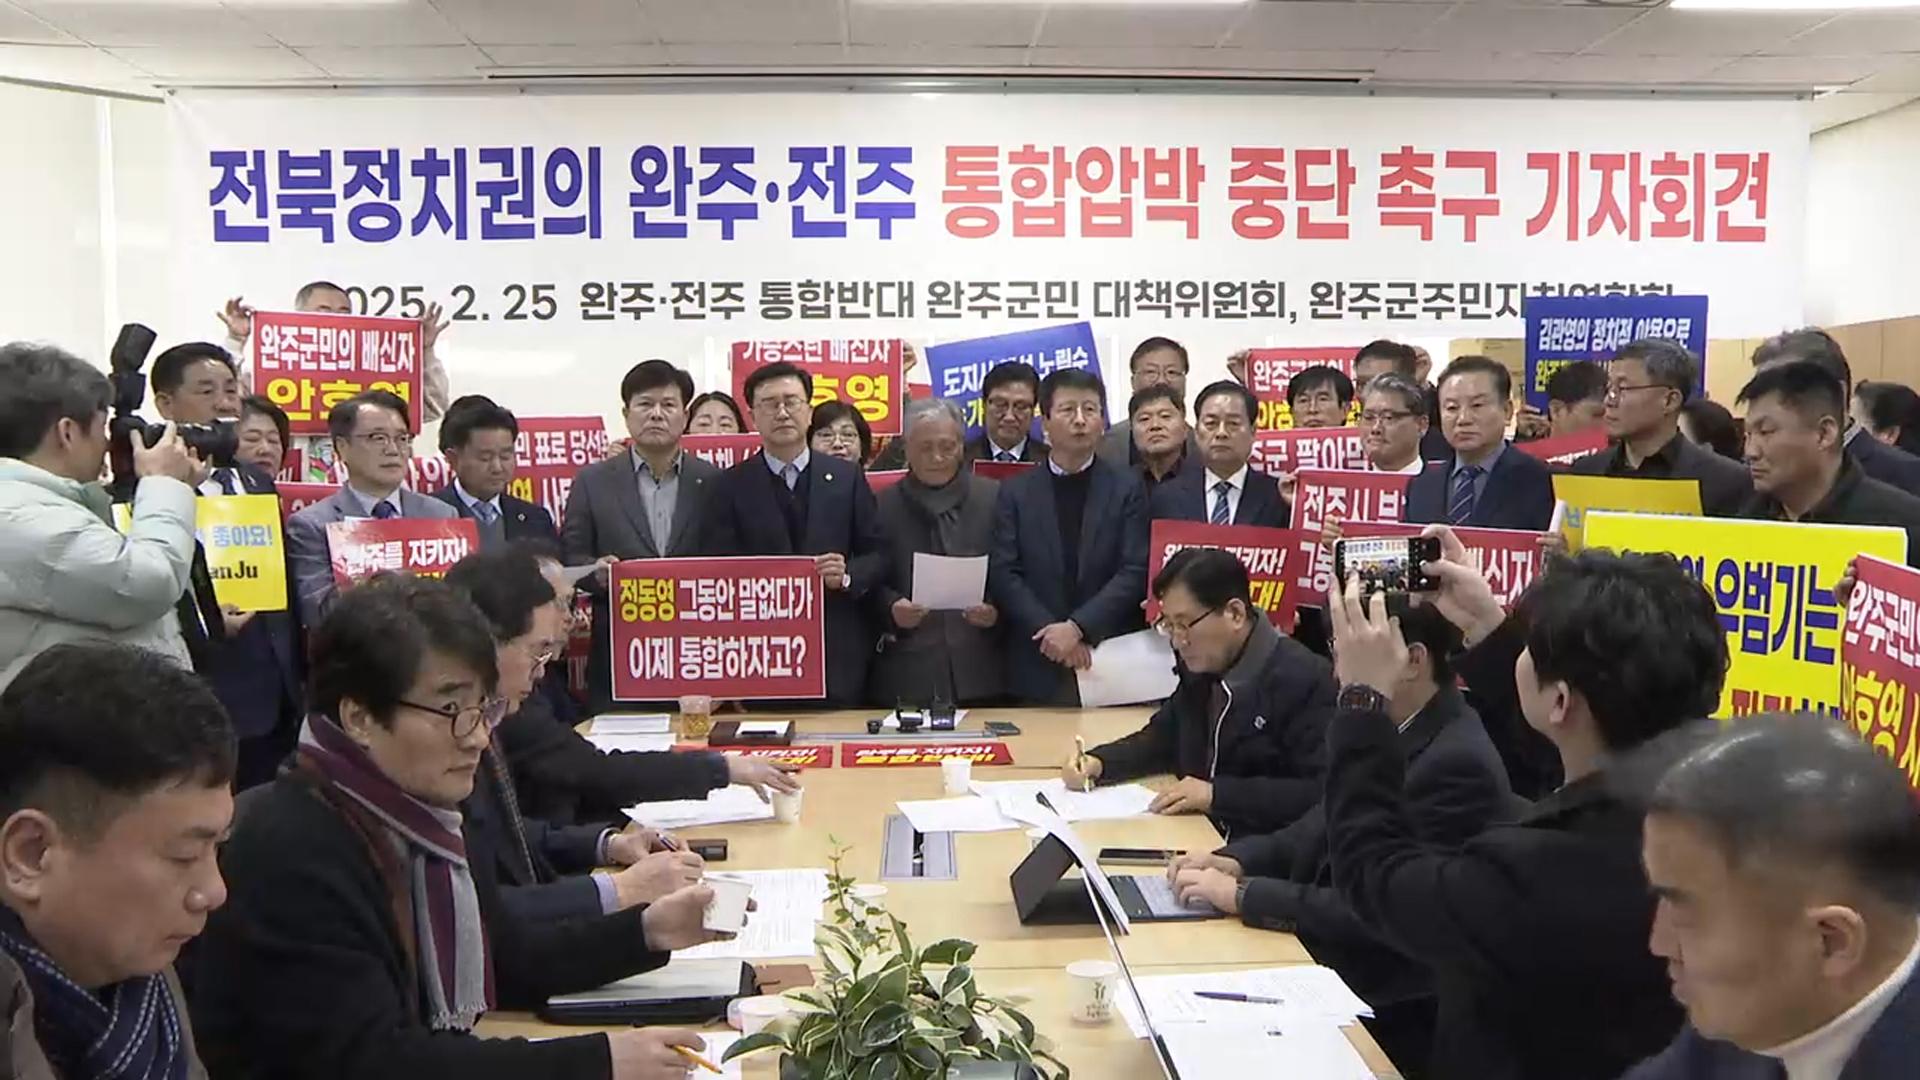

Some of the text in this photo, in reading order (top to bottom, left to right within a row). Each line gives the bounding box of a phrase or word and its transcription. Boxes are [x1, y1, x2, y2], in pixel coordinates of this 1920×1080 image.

[209, 144, 1771, 243] 전북정치권의 완주·전주 통합압박 중단 촉구 기자회견
[580, 281, 745, 321] 완주·전주
[759, 280, 914, 320] 통합반대
[927, 280, 1080, 320] 완주군민
[1092, 280, 1298, 326] 대책위원회,
[260, 323, 416, 374] 완주군민의 배신자
[1539, 317, 1590, 352] 김관영의
[1592, 317, 1633, 352] 정치적
[534, 430, 569, 466] 표로
[618, 575, 814, 623] 정동영 그동안 말없다가
[1713, 557, 1840, 666] 우범기는
[628, 635, 674, 680] 이제
[678, 634, 807, 681] 통합하자고?
